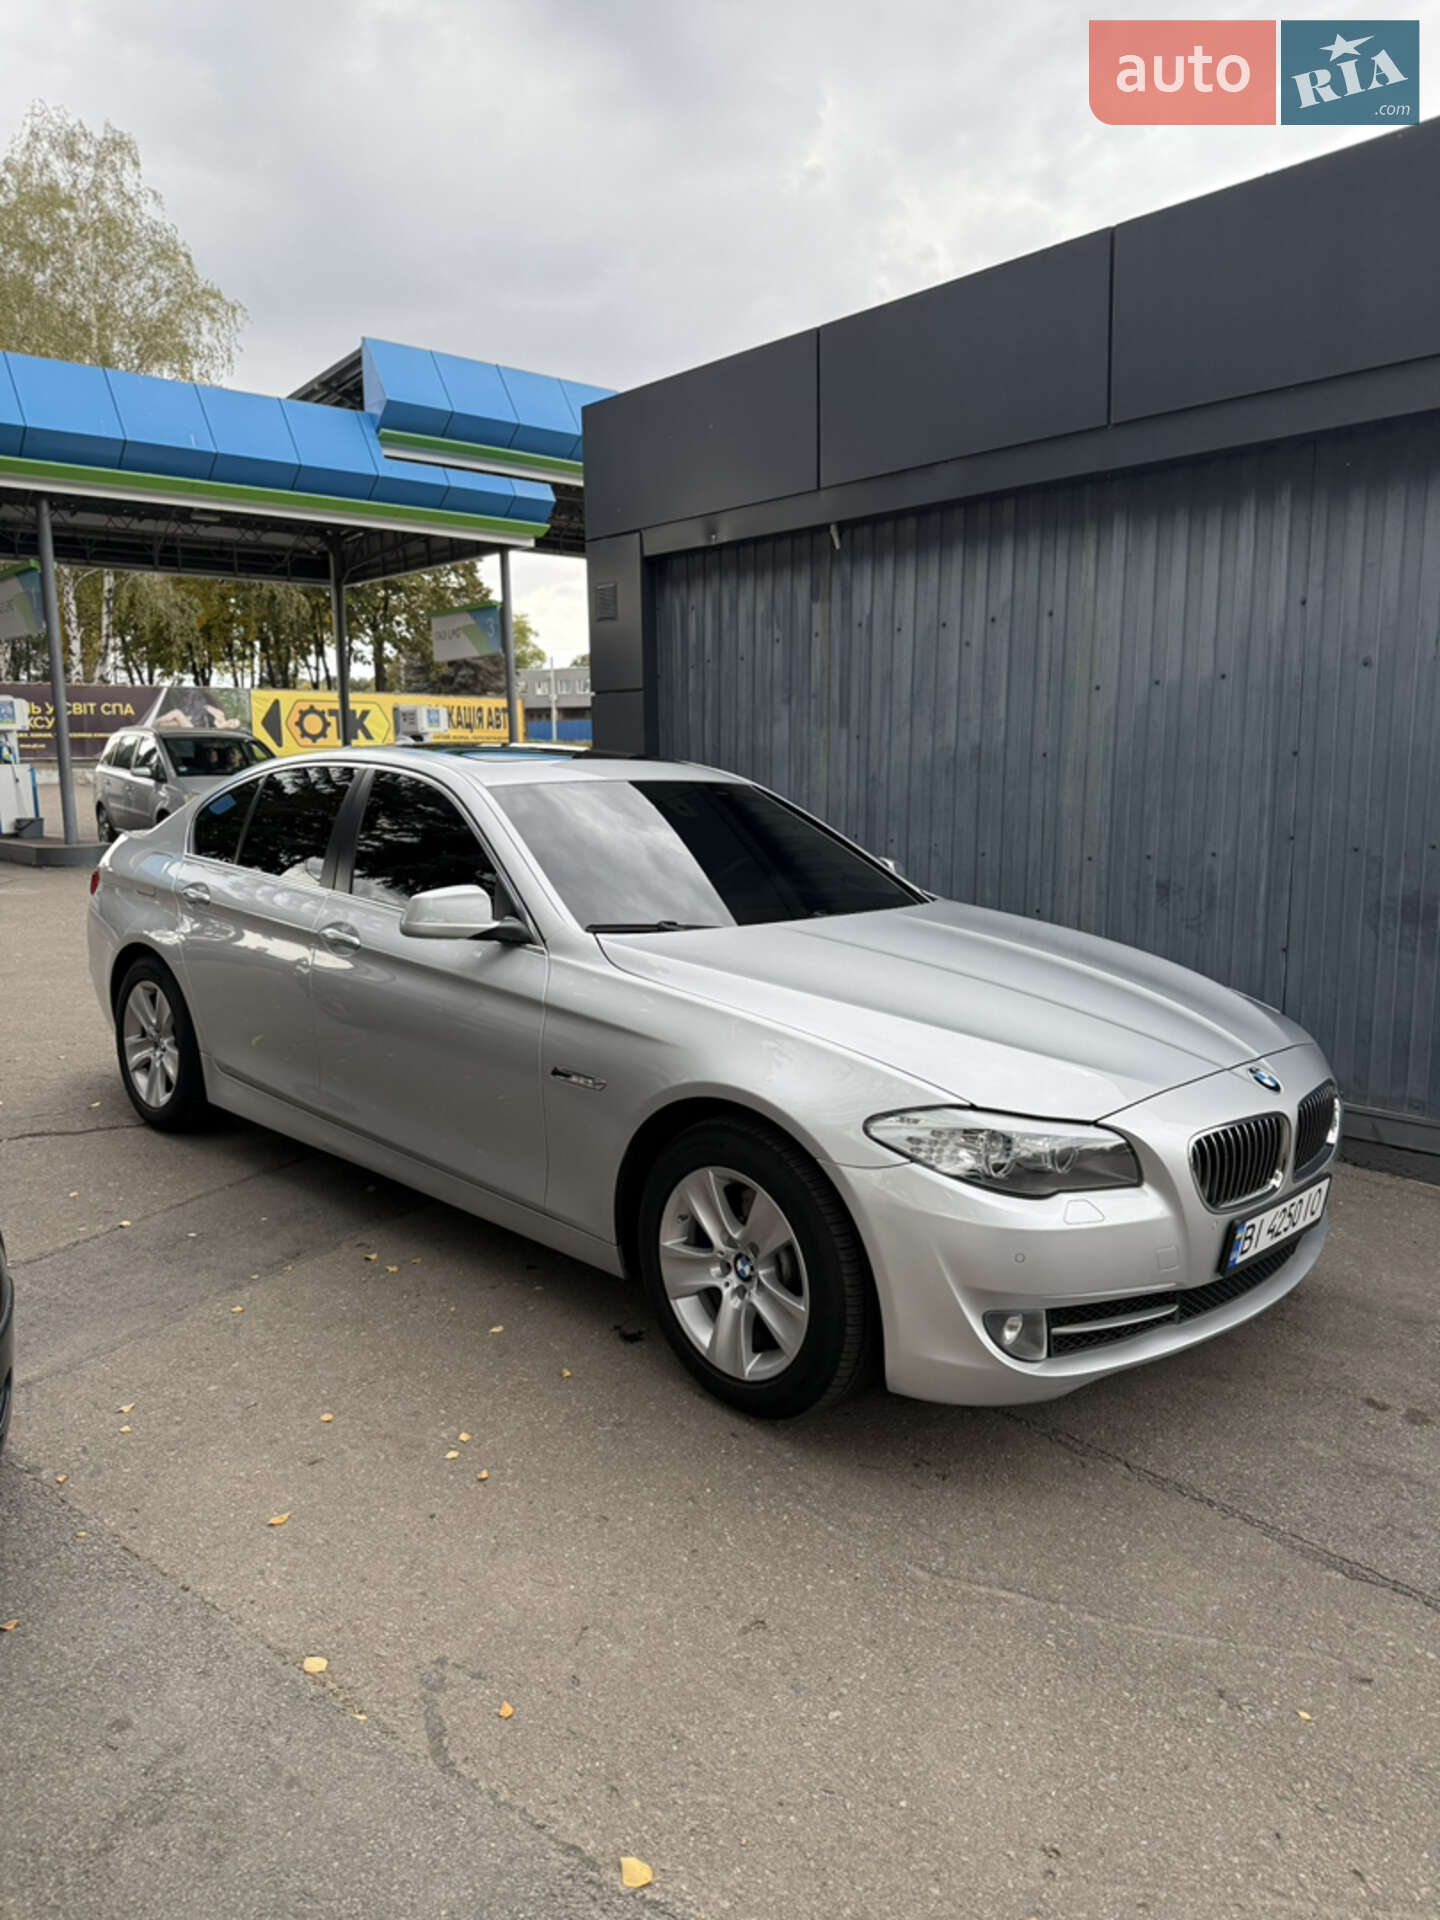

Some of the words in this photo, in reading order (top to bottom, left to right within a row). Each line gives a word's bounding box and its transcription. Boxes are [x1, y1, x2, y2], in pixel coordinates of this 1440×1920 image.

[100, 702, 136, 716] СПА
[486, 706, 510, 729] АВТ
[1266, 1198, 1304, 1241] 4250
